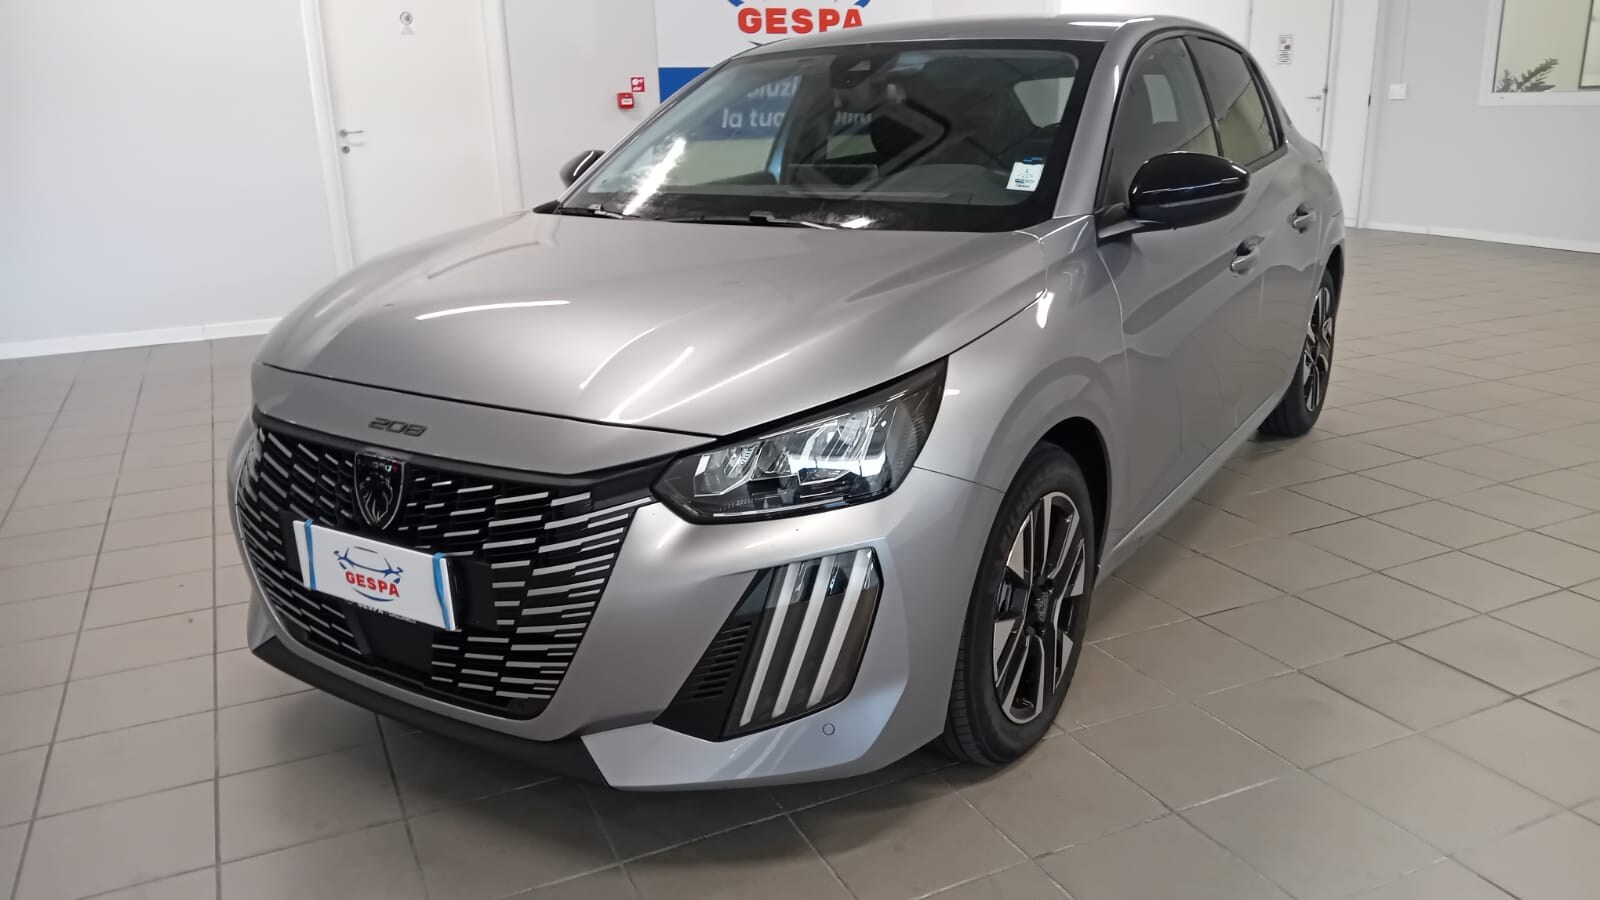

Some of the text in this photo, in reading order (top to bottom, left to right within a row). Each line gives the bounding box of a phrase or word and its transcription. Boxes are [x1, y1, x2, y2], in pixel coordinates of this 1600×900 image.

[738, 8, 863, 34] GESPA
[722, 108, 743, 128] la
[368, 417, 427, 437] 208
[345, 571, 400, 597] GESPA
